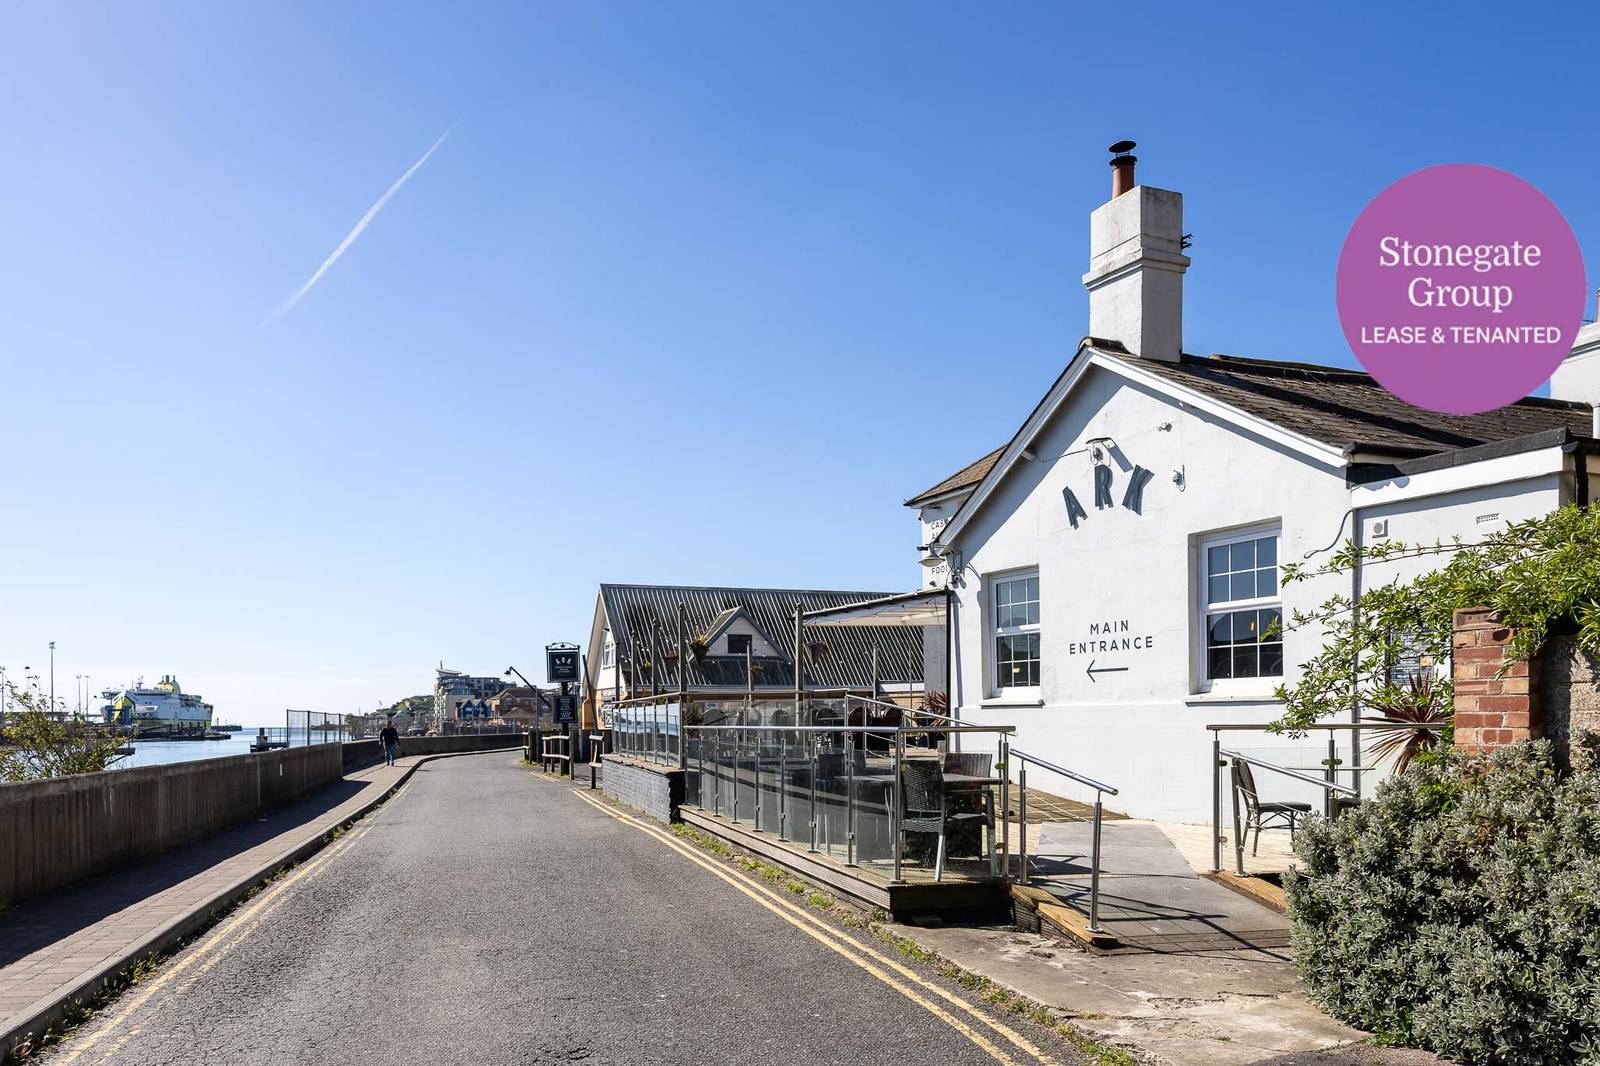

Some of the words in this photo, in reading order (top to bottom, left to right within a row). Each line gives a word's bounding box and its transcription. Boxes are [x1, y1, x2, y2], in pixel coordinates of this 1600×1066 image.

[1062, 464, 1155, 530] ARK
[931, 564, 948, 575] FOO
[1090, 619, 1129, 635] MAIN
[1069, 635, 1153, 655] ENTRANCE
